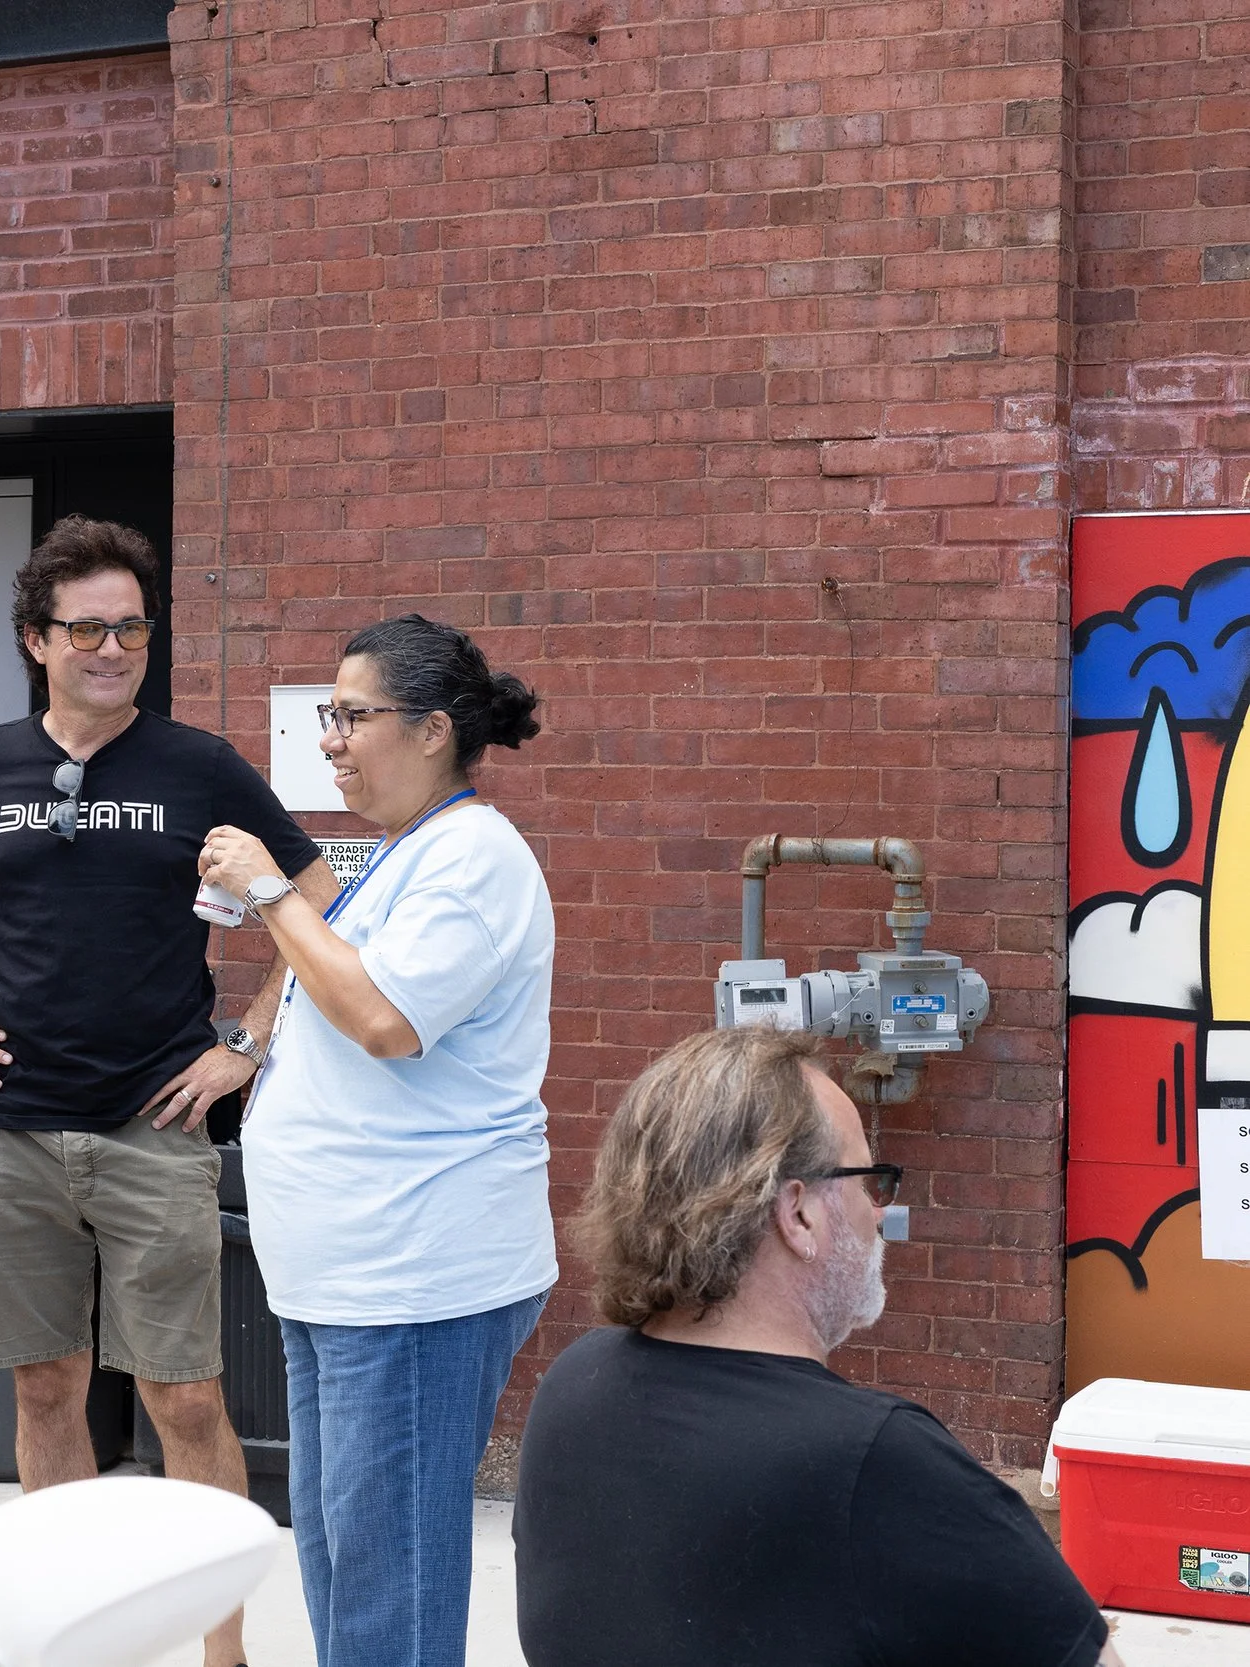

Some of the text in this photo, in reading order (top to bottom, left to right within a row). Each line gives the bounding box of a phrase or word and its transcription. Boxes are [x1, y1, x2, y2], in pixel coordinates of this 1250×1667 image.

[331, 845, 374, 854] ROADSID
[326, 855, 365, 863] ISTANCE
[1175, 1491, 1250, 1515] IGLO
[1211, 1551, 1238, 1560] IGLOO
